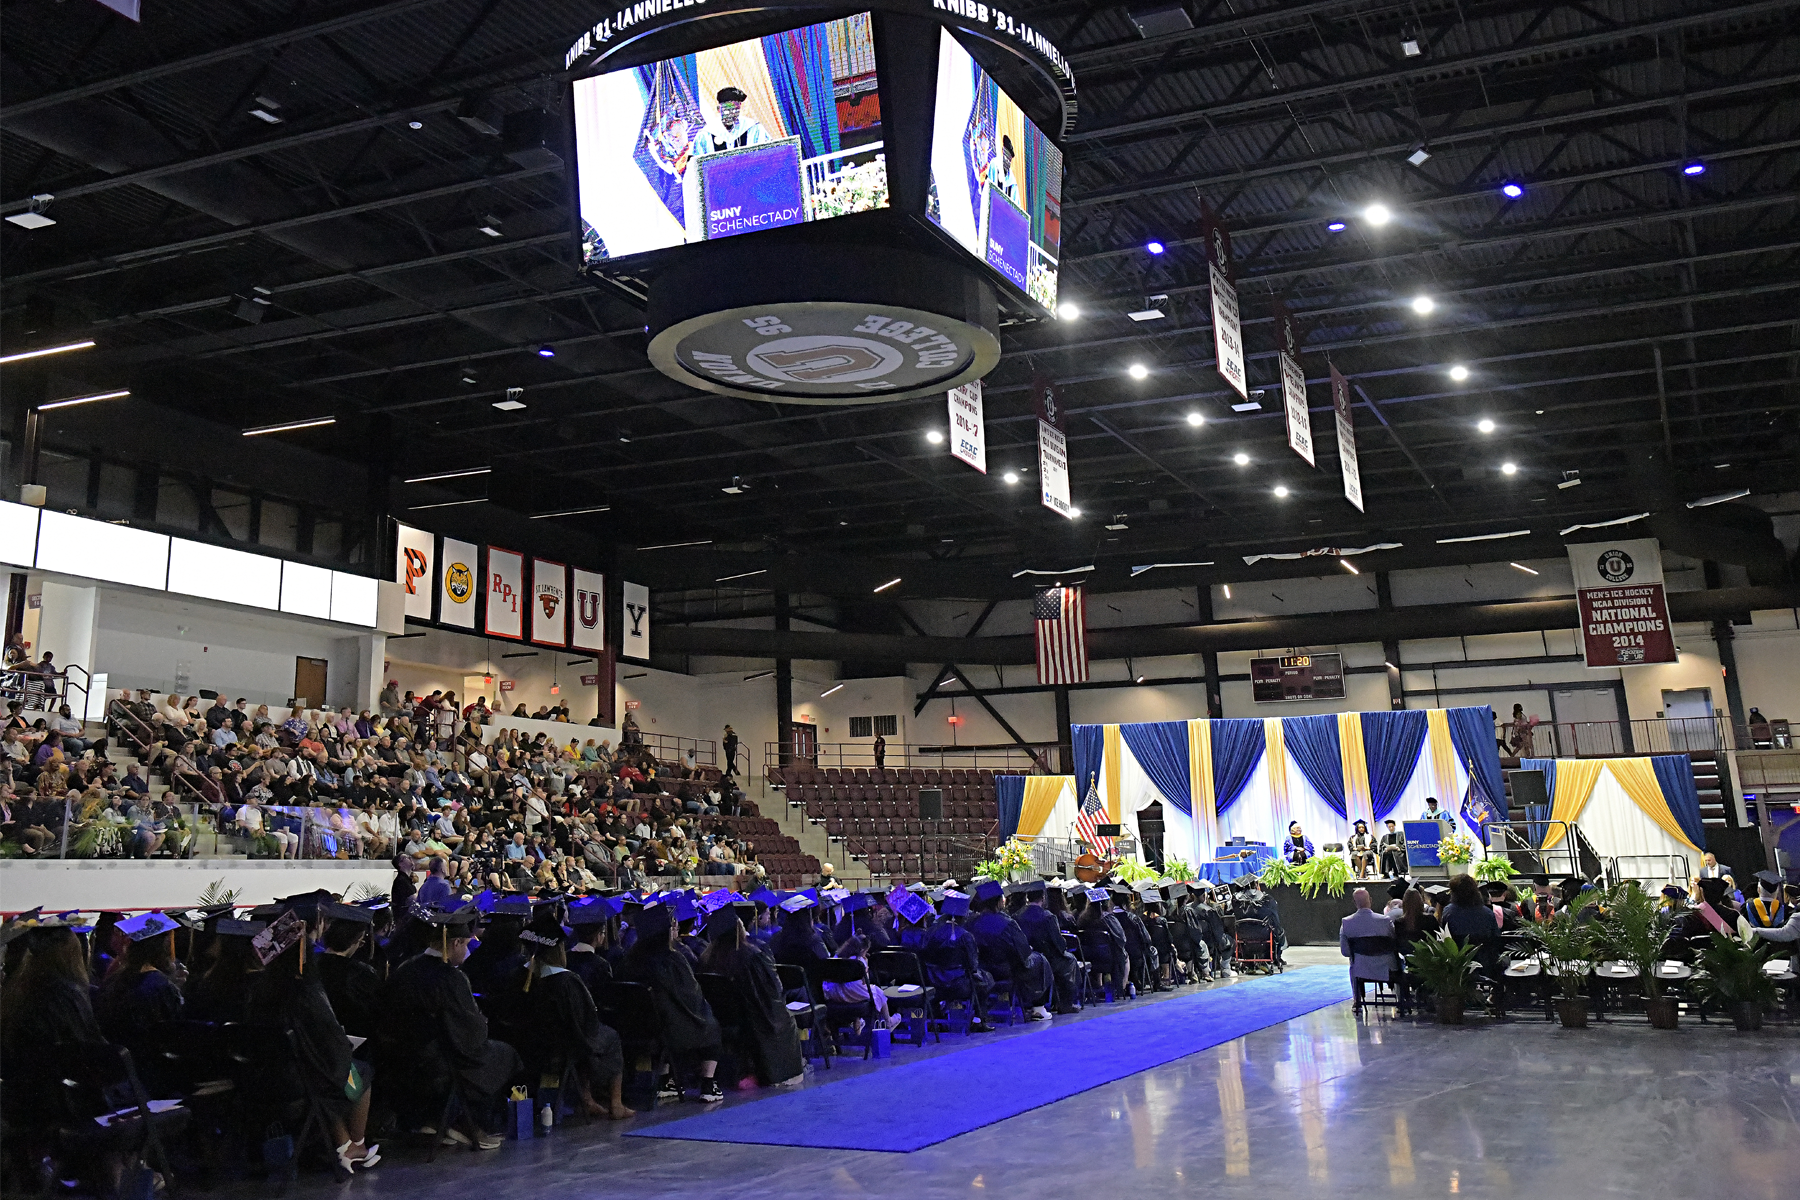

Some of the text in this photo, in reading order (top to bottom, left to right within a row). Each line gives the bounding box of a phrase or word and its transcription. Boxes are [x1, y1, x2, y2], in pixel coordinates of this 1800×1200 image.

[565, 31, 591, 70] KNIBB
[710, 206, 742, 222] SUNY
[711, 207, 800, 234] SCHENECTADY
[403, 547, 428, 595] P
[492, 573, 518, 612] RPI
[1587, 590, 1610, 599] MEN'S
[1625, 588, 1654, 597] HOCKEY
[577, 589, 600, 629] U
[1592, 600, 1613, 608] NCAA
[1614, 597, 1647, 607] DIVISION
[625, 602, 646, 638] Y
[1592, 607, 1657, 621] NATIONAL
[1588, 620, 1665, 636] CHAMPIONS
[1612, 635, 1644, 648] 2014
[1284, 656, 1310, 666] 11:20
